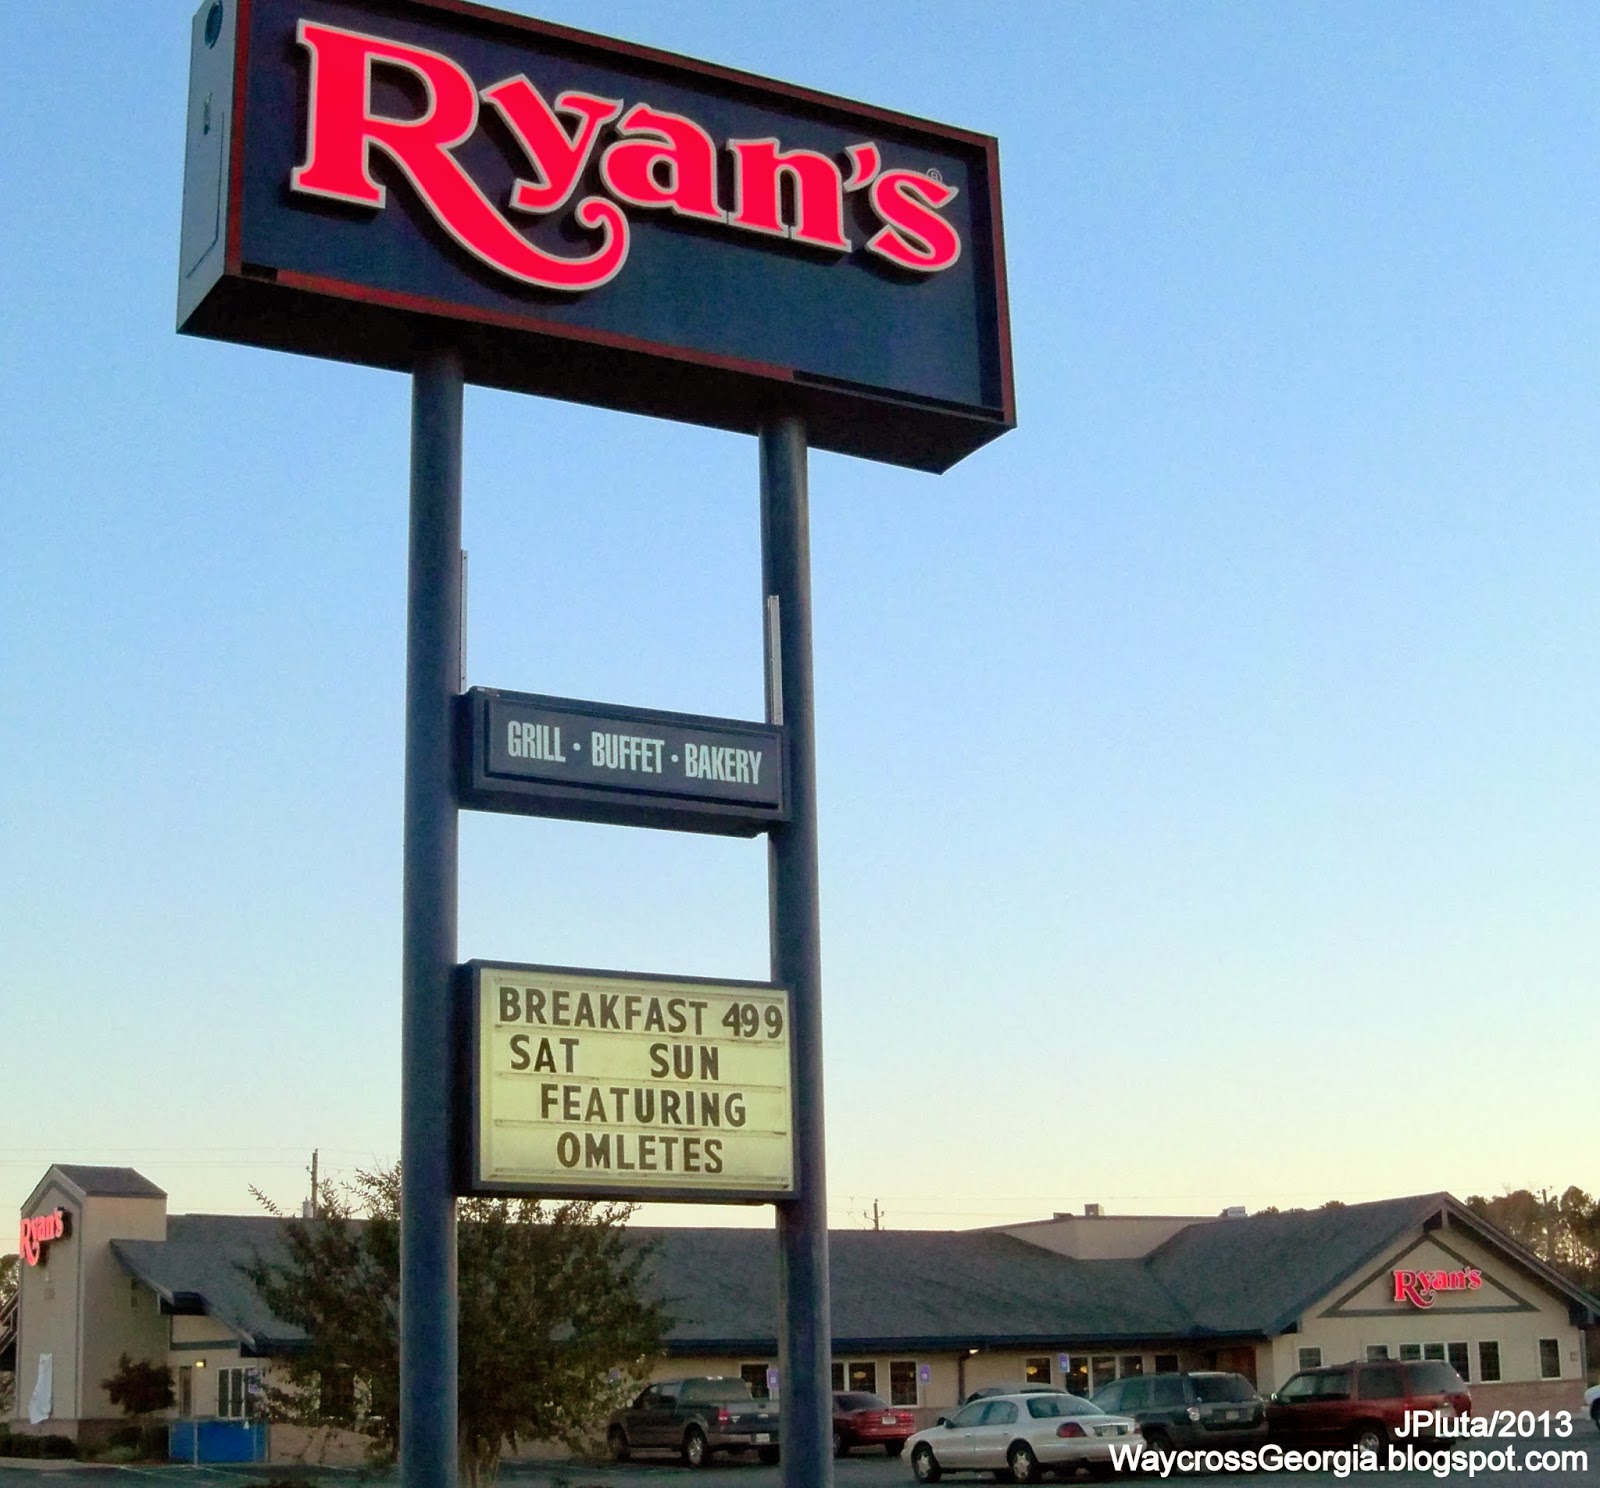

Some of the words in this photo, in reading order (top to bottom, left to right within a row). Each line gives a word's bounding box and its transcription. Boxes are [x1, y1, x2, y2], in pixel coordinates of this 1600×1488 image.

[290, 19, 962, 292] Ryan's
[507, 720, 566, 763] GRILL
[591, 731, 665, 774] BUFFET
[685, 743, 762, 785] BAKERY
[499, 986, 708, 1036] BREAKFAST
[722, 1002, 783, 1039] 499
[509, 1033, 580, 1073] SAT
[649, 1042, 719, 1081] SUN
[540, 1083, 747, 1128] FEATURING
[556, 1131, 723, 1174] OMLETES
[19, 1208, 64, 1267] Ryan's
[1393, 1267, 1483, 1309] Ryan's
